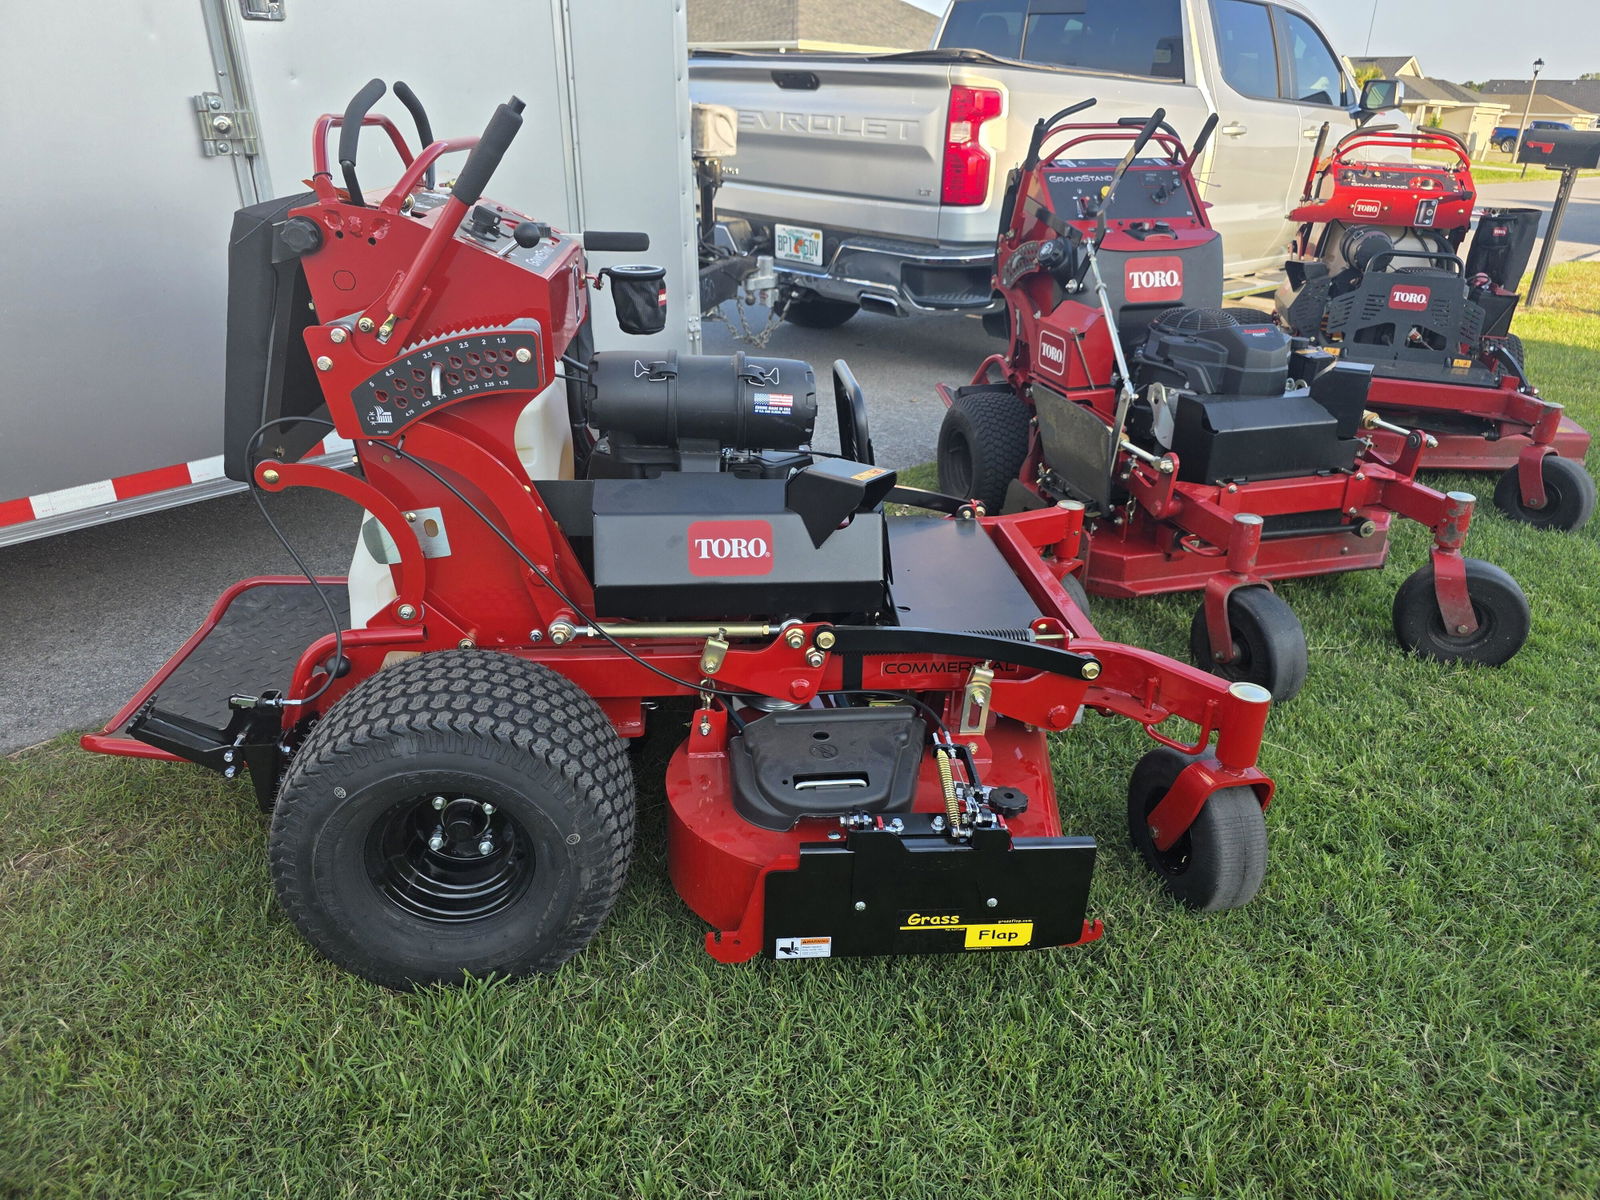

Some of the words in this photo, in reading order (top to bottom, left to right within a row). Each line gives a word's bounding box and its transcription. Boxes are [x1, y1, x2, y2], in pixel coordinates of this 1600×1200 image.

[736, 109, 920, 140] EVROLET
[1356, 204, 1378, 213] TORO
[1129, 270, 1179, 289] TORO
[1393, 291, 1426, 304] TORO
[385, 368, 395, 377] 4.5
[422, 351, 433, 359] 3.5
[458, 341, 469, 349] 2.5
[1041, 342, 1063, 363] TORO
[694, 537, 767, 559] TORO
[884, 661, 1016, 675] COMMERAL
[907, 913, 960, 925] Grass
[978, 930, 1018, 942] Flap
